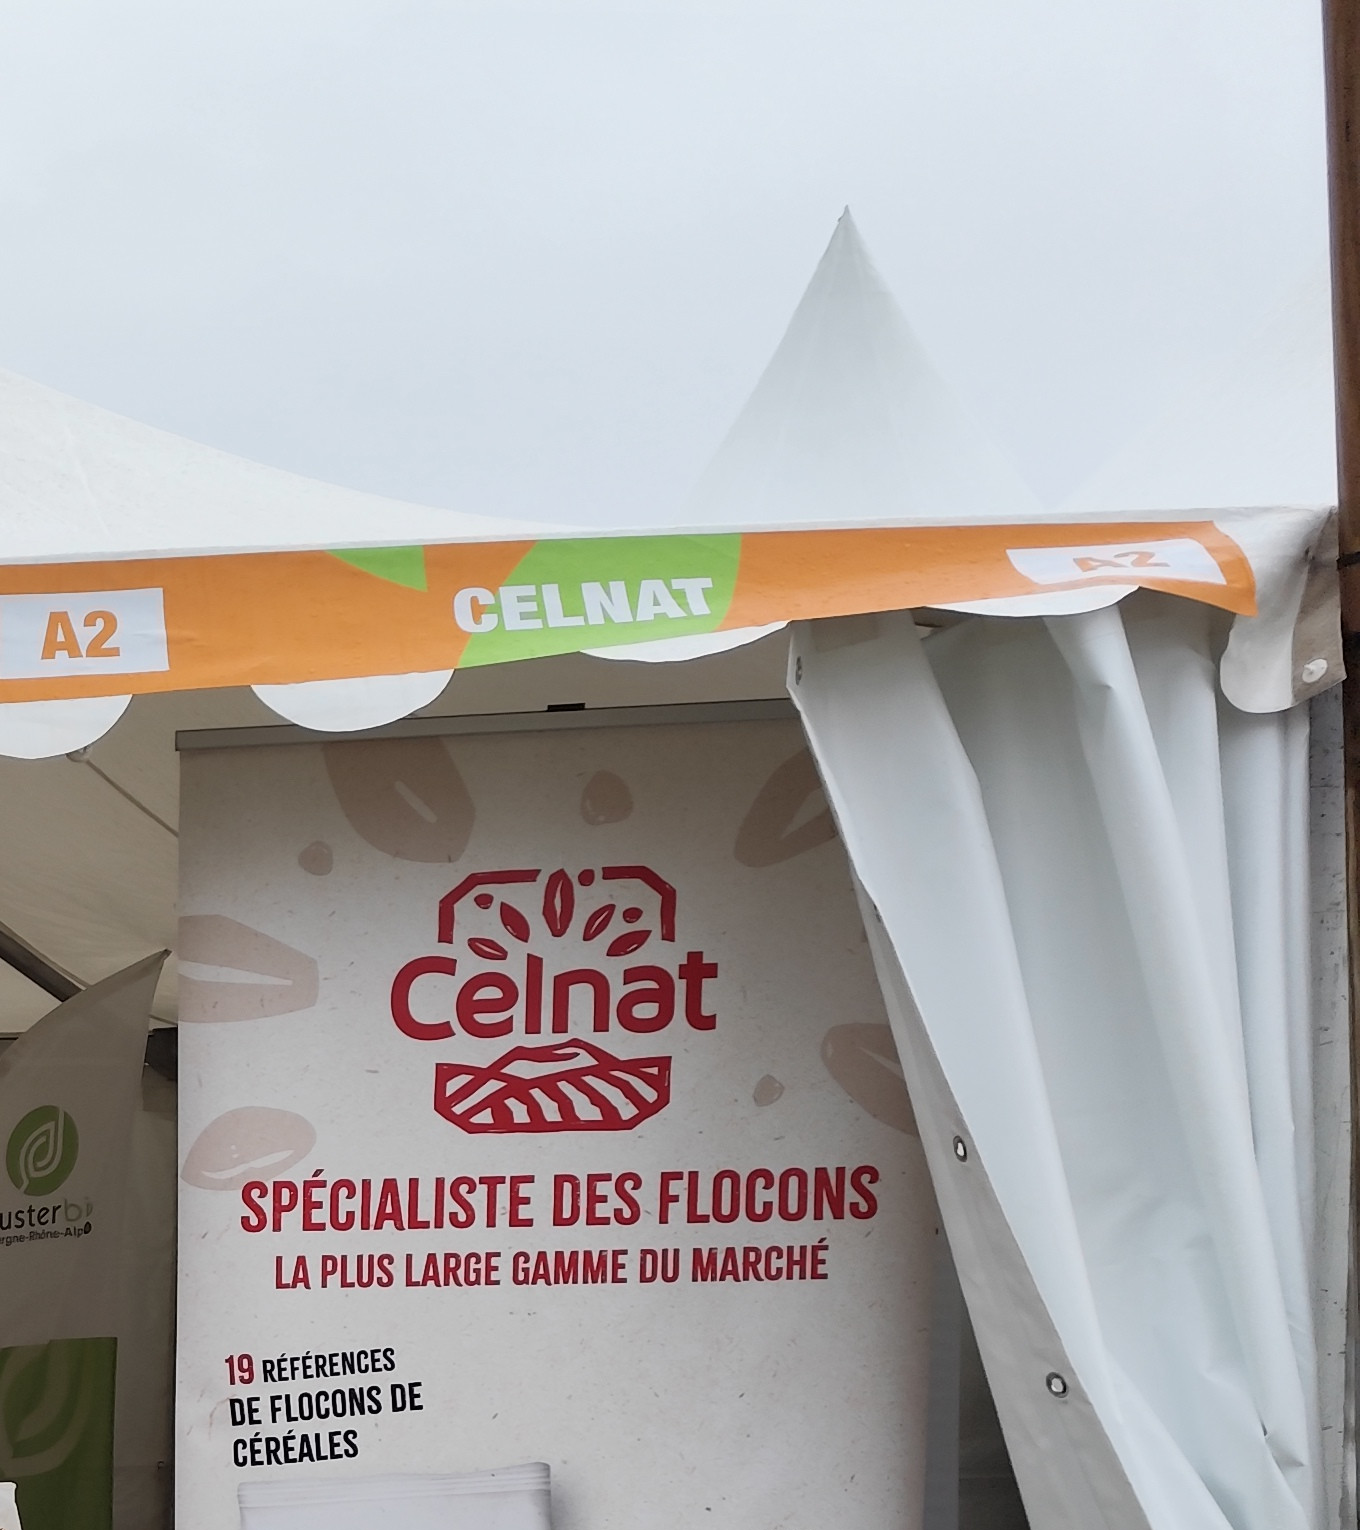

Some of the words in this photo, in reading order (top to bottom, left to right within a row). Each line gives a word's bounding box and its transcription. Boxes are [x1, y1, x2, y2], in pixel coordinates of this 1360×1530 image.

[1071, 551, 1170, 573] A2
[453, 577, 715, 635] CELNAT
[40, 610, 121, 660] A2
[390, 951, 718, 1041] Celnat
[240, 1168, 535, 1233] SPÉCIALISTE
[552, 1171, 642, 1228] DES
[658, 1164, 879, 1224] FLOCONS
[275, 1254, 310, 1290] LA
[321, 1252, 394, 1288] PLUS
[404, 1251, 501, 1287] LARGE
[512, 1249, 628, 1286] GAMME
[638, 1247, 680, 1284] DU
[690, 1237, 829, 1283] MARCHÉ
[224, 1352, 255, 1386] 19
[261, 1347, 396, 1384] RÉFÉRENCES
[229, 1396, 262, 1426] DE
[270, 1385, 382, 1424] FLOCONS
[390, 1381, 424, 1413] DE
[232, 1429, 359, 1468] CÉRÉALES
